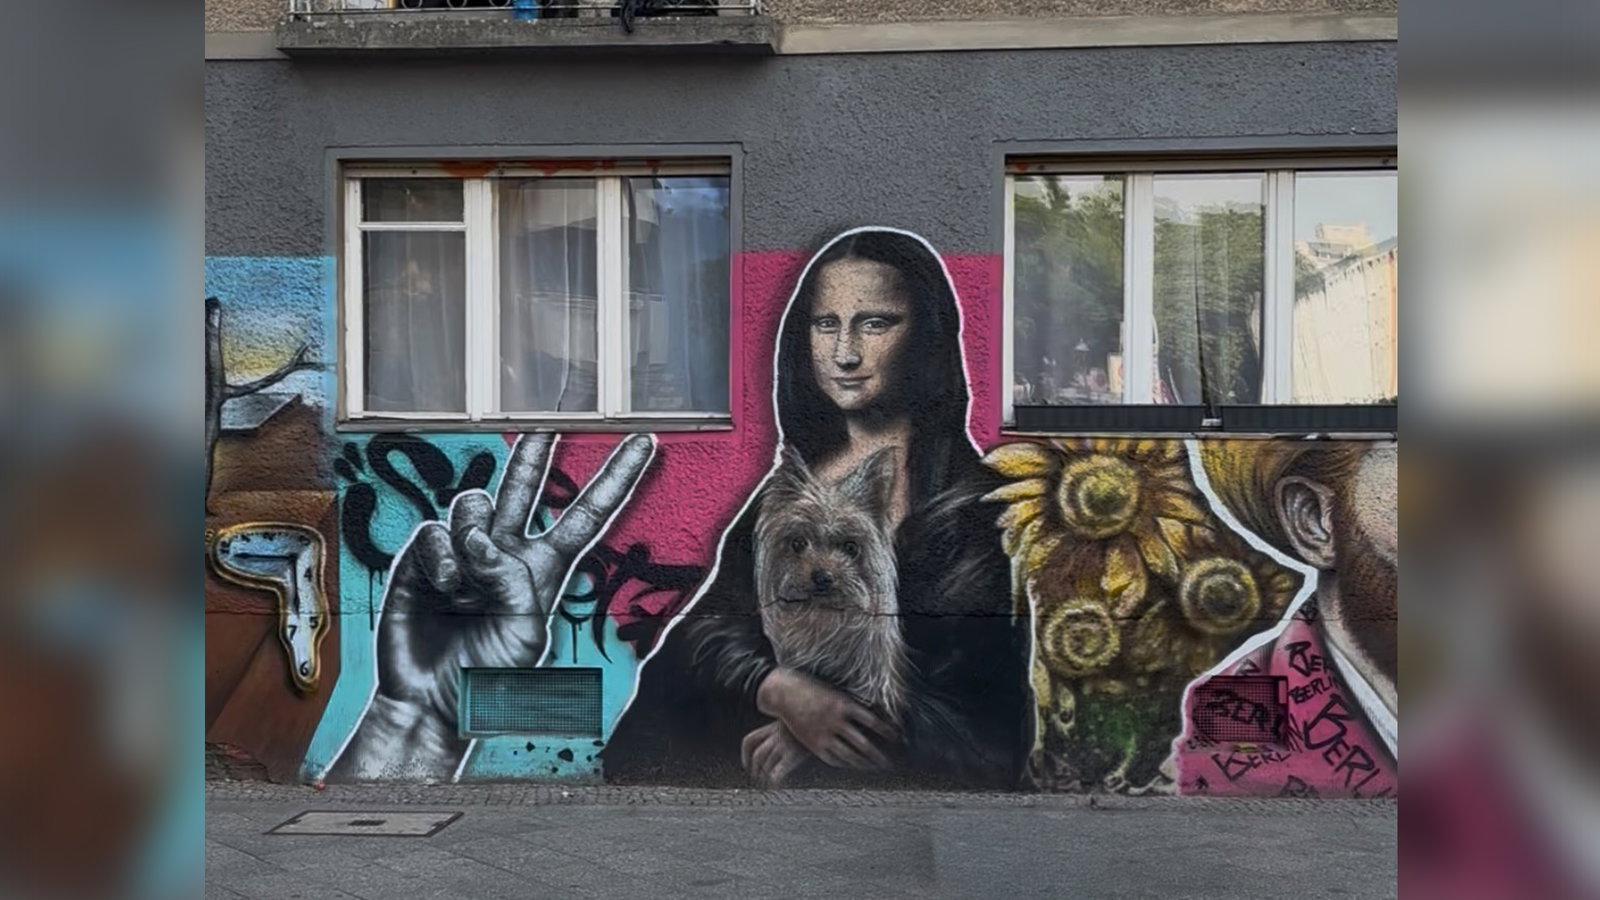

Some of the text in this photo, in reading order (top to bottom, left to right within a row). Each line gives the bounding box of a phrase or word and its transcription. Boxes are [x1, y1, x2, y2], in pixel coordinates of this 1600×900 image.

[304, 567, 313, 582] 4
[310, 616, 319, 629] 5
[288, 625, 298, 640] 7
[300, 662, 309, 676] 6
